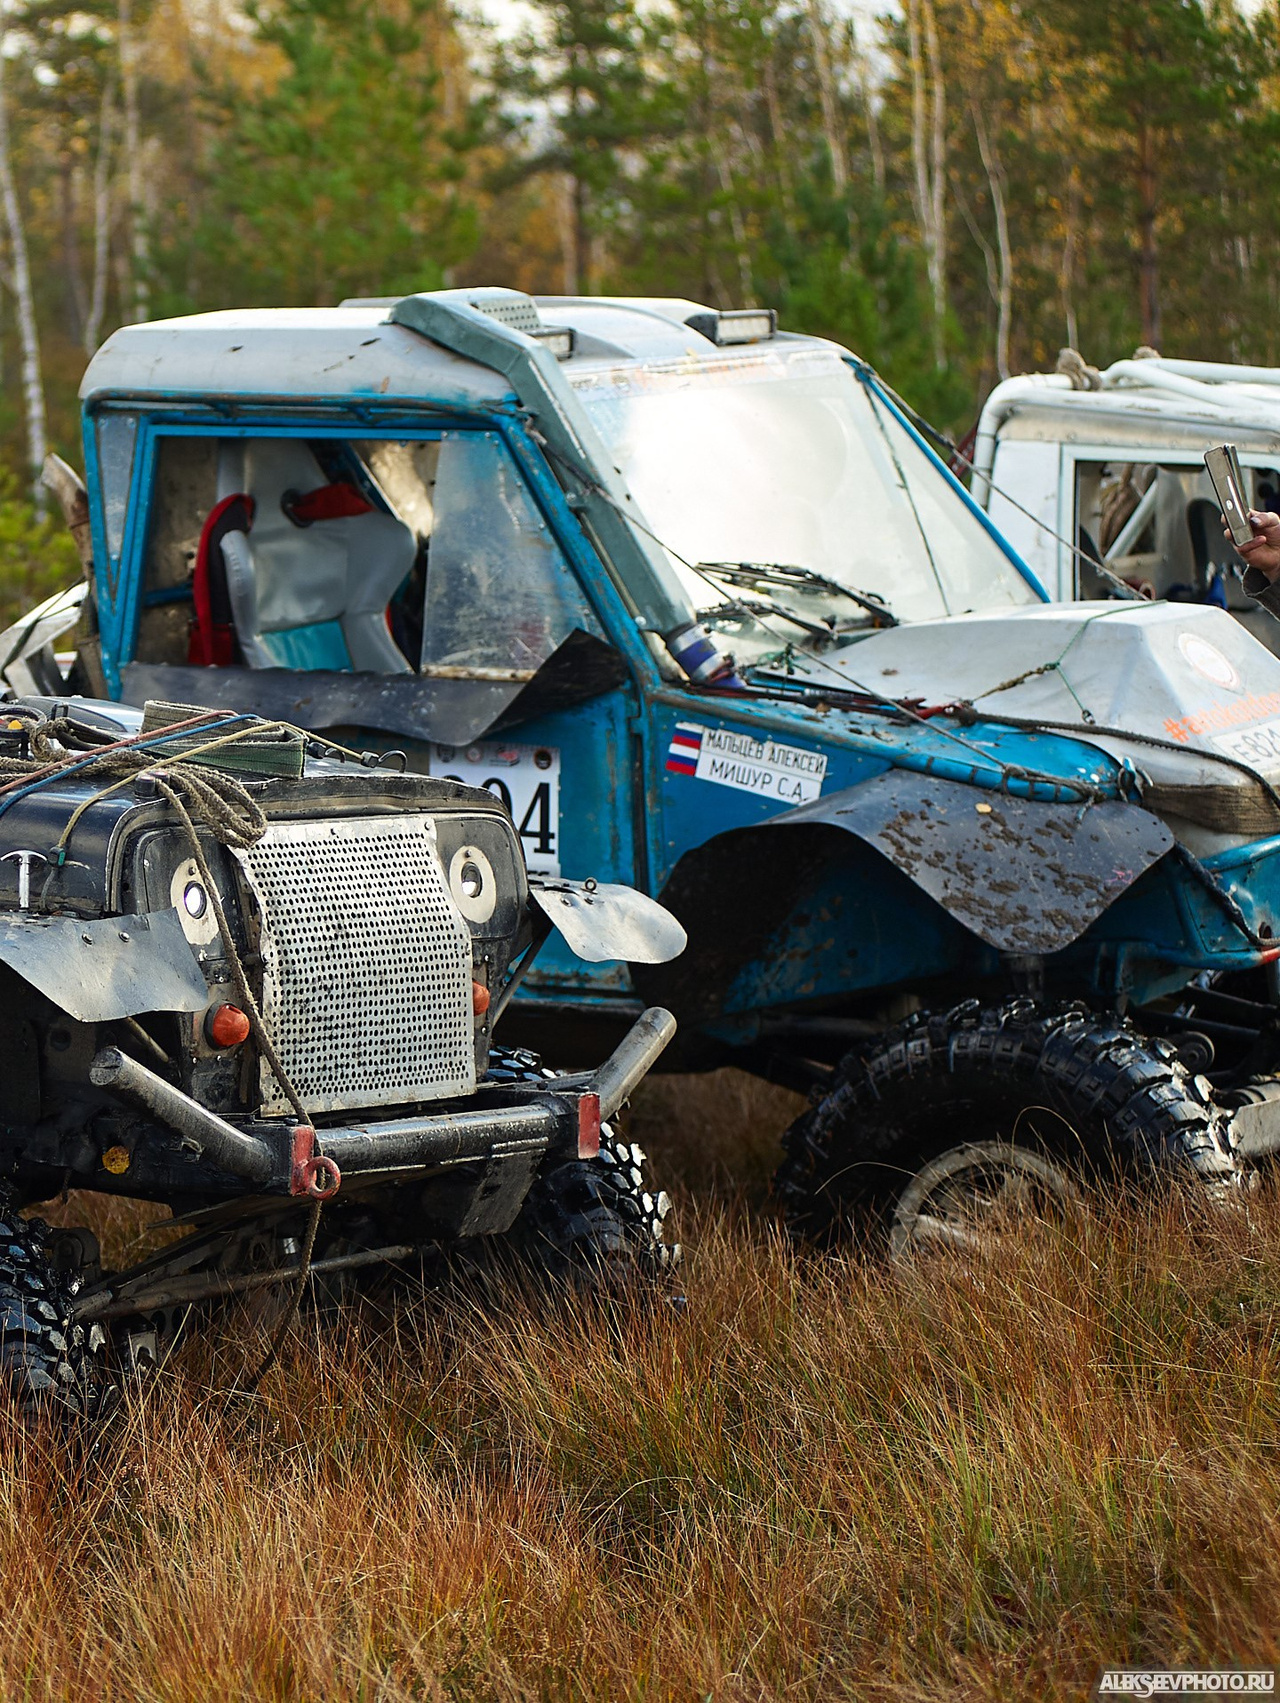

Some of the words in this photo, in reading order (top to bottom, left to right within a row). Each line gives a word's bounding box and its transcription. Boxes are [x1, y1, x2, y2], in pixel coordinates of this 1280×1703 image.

[706, 731, 764, 761] МАЛЬЦЕВ
[768, 746, 825, 775] АЛЕКСЕЙ
[709, 758, 773, 790] МИШУР
